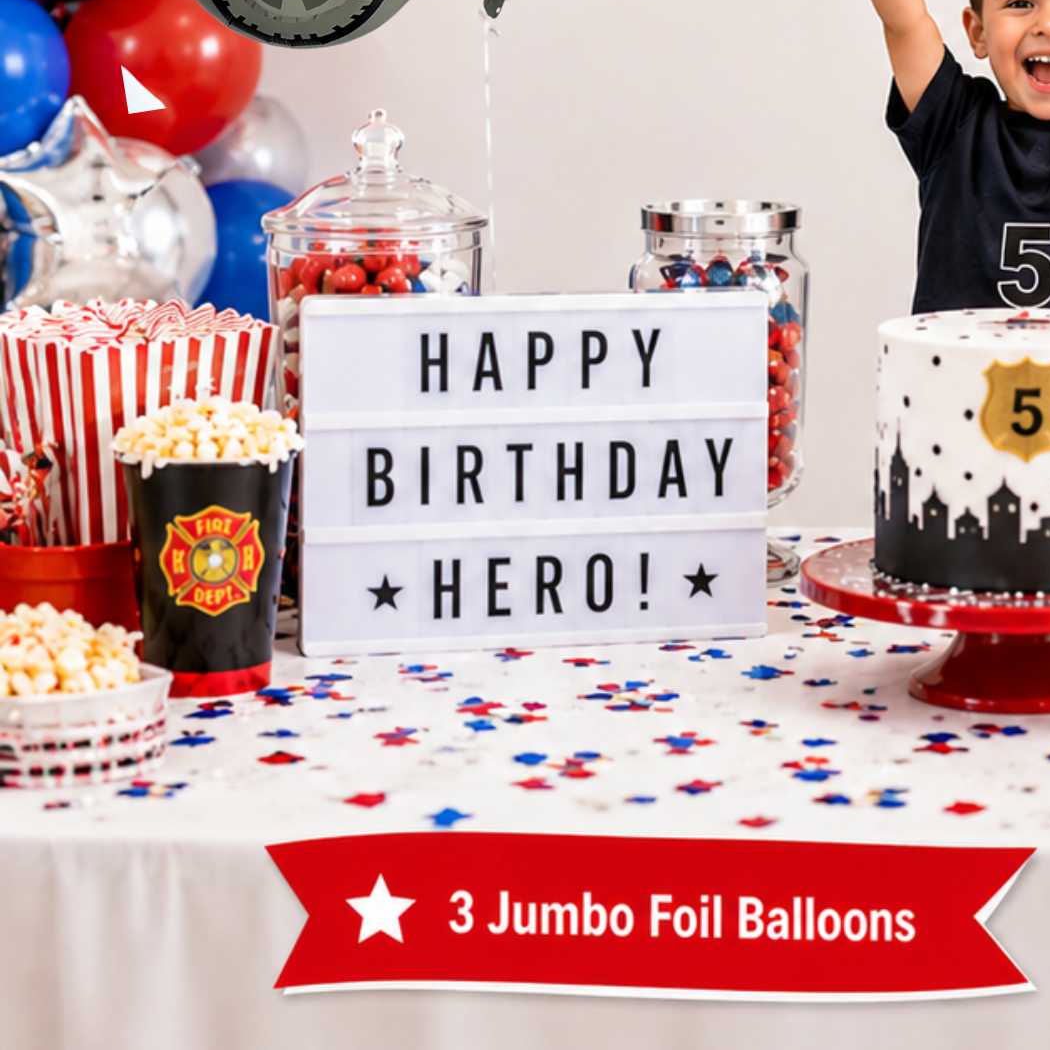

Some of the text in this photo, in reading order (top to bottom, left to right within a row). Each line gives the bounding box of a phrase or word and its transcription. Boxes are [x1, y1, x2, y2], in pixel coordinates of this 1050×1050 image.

[420, 328, 661, 393] HAPPY
[1011, 387, 1043, 437] 5
[366, 438, 733, 508] BIRTHDAY
[433, 552, 649, 620] HERO!
